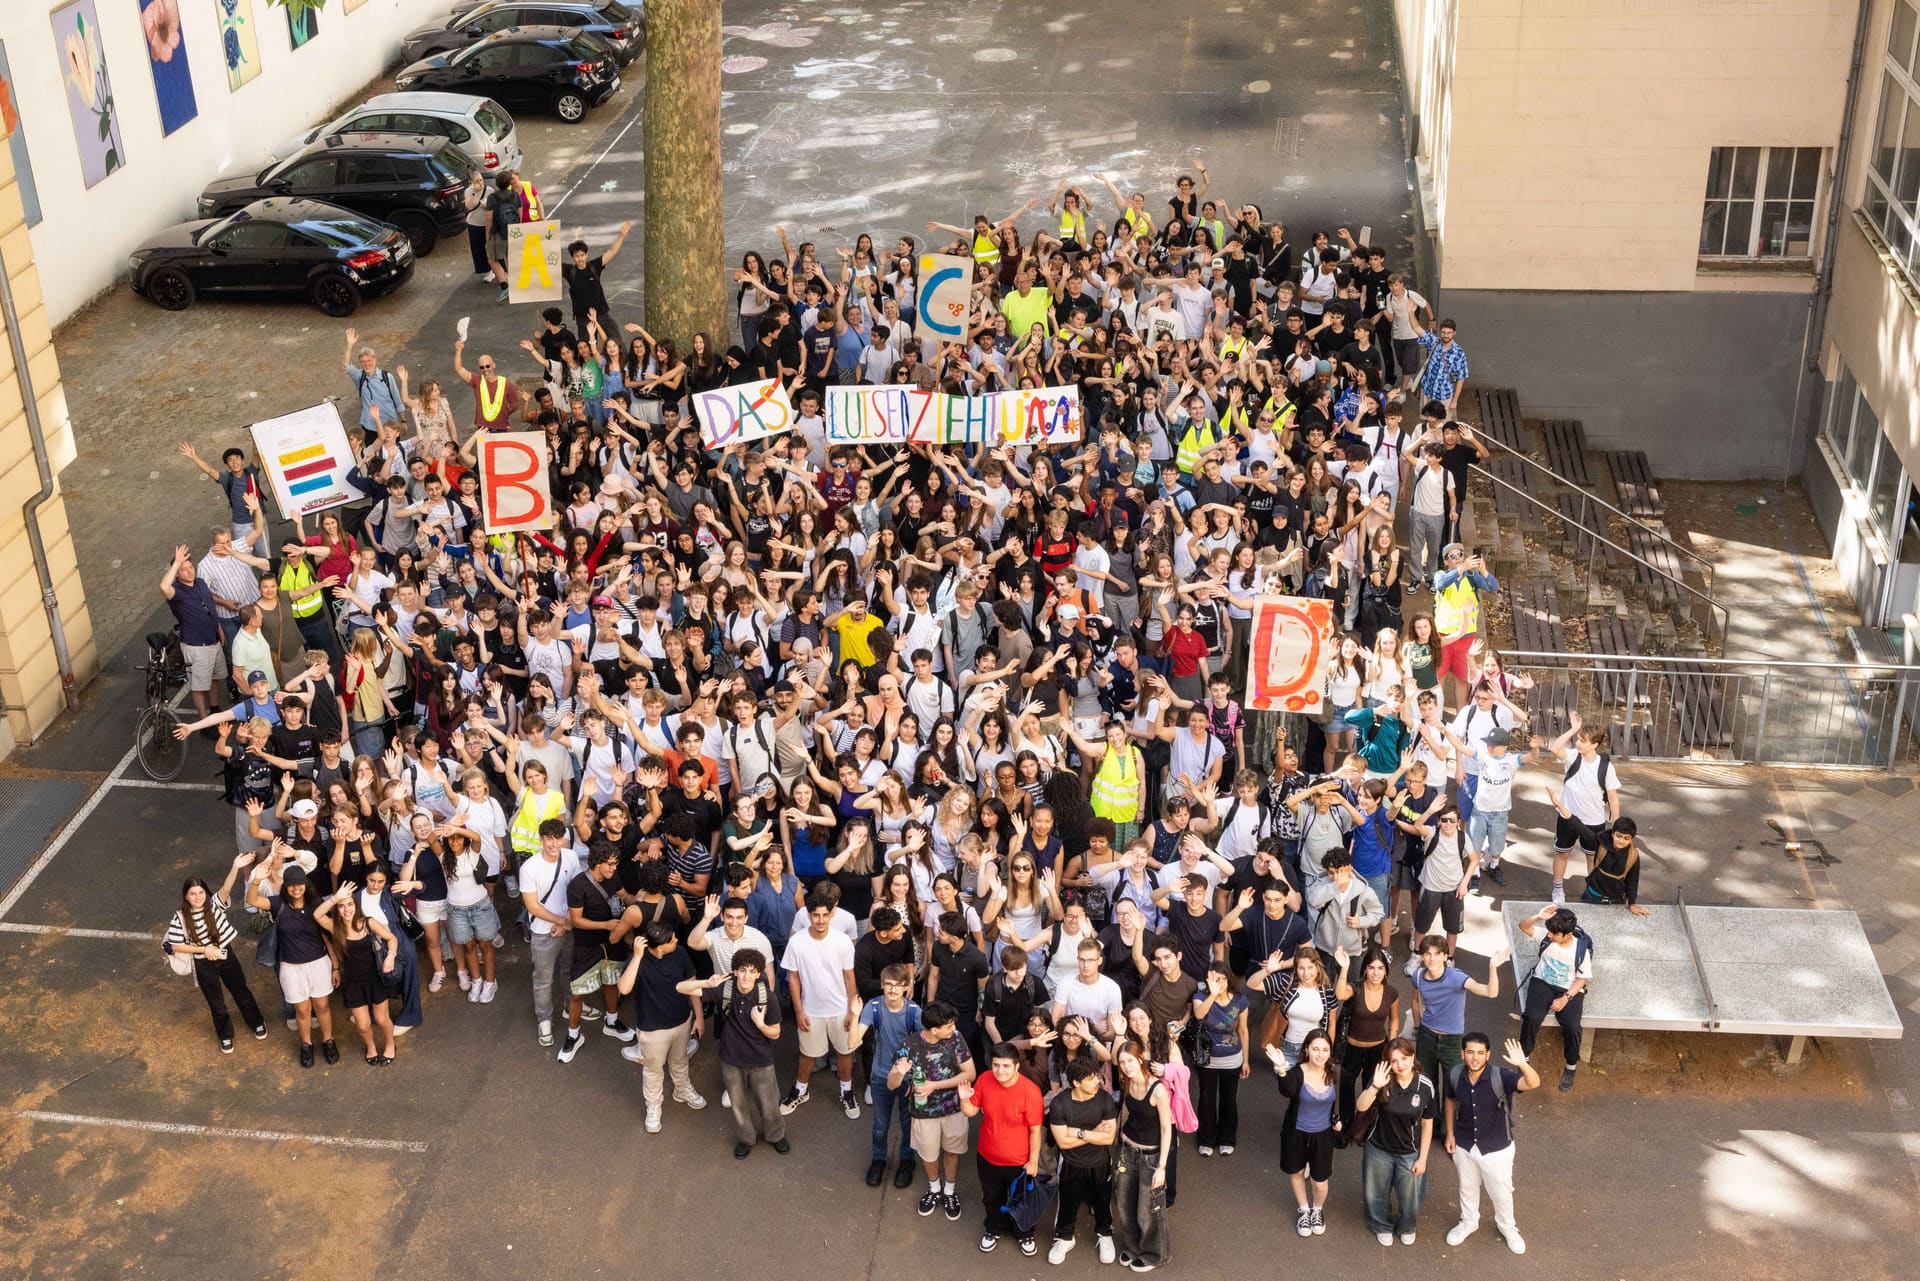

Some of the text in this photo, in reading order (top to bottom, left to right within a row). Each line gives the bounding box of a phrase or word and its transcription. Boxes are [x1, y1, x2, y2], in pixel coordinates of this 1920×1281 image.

[516, 233, 553, 288] A
[919, 267, 963, 335] C
[702, 385, 788, 443] DAS
[484, 440, 545, 527] B
[1254, 603, 1320, 697] D
